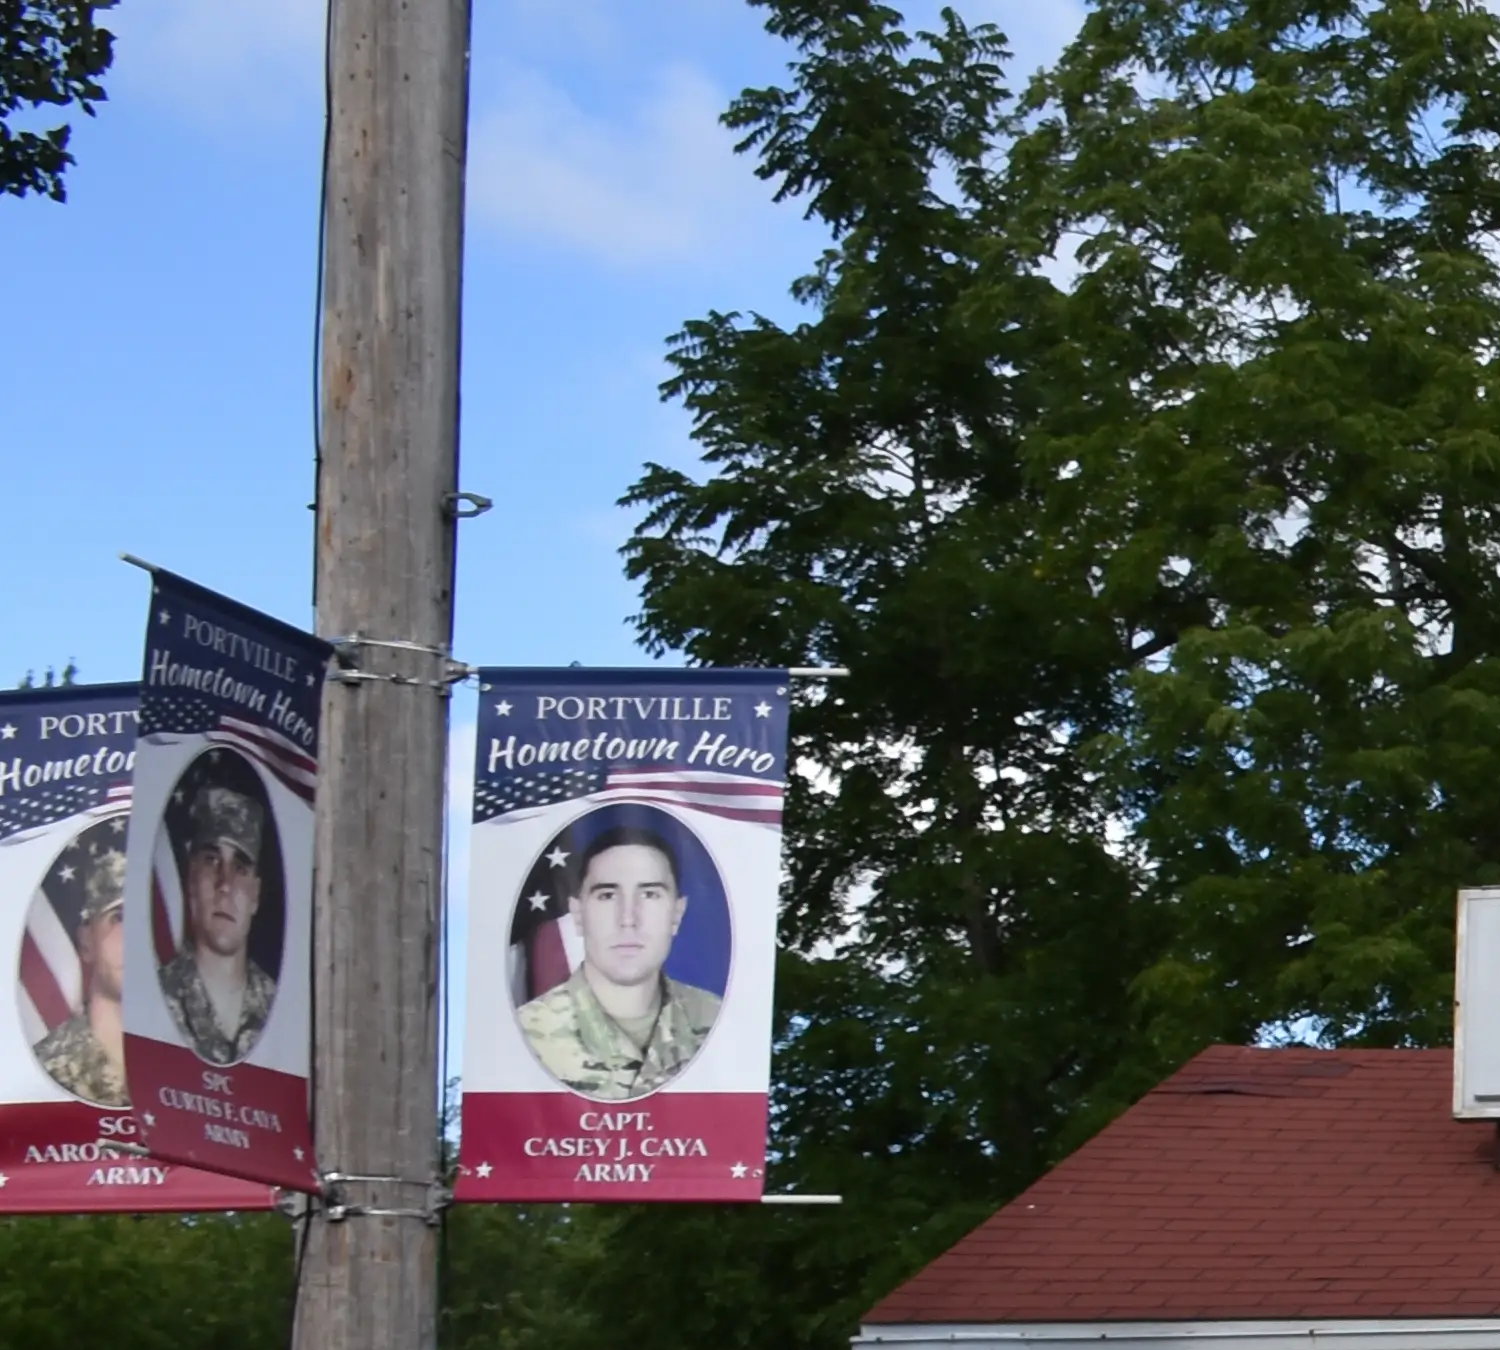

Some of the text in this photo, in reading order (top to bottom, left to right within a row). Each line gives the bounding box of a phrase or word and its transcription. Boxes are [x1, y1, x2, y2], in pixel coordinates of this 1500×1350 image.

[183, 614, 298, 683] PORTVILLE
[149, 648, 316, 746] Hometown Hero
[536, 696, 733, 721] PORTVILLE
[487, 730, 776, 774] Hometown Hero
[202, 1071, 234, 1095] SPC
[158, 1087, 224, 1119] CURTIS
[240, 1106, 282, 1133] CAYA
[579, 1112, 654, 1131] CAPT.
[98, 1116, 137, 1136] SG
[204, 1123, 251, 1149] ARMY
[524, 1137, 707, 1161] CASEY J. CAYA
[87, 1166, 170, 1186] ARMY
[574, 1163, 656, 1183] ARMY
